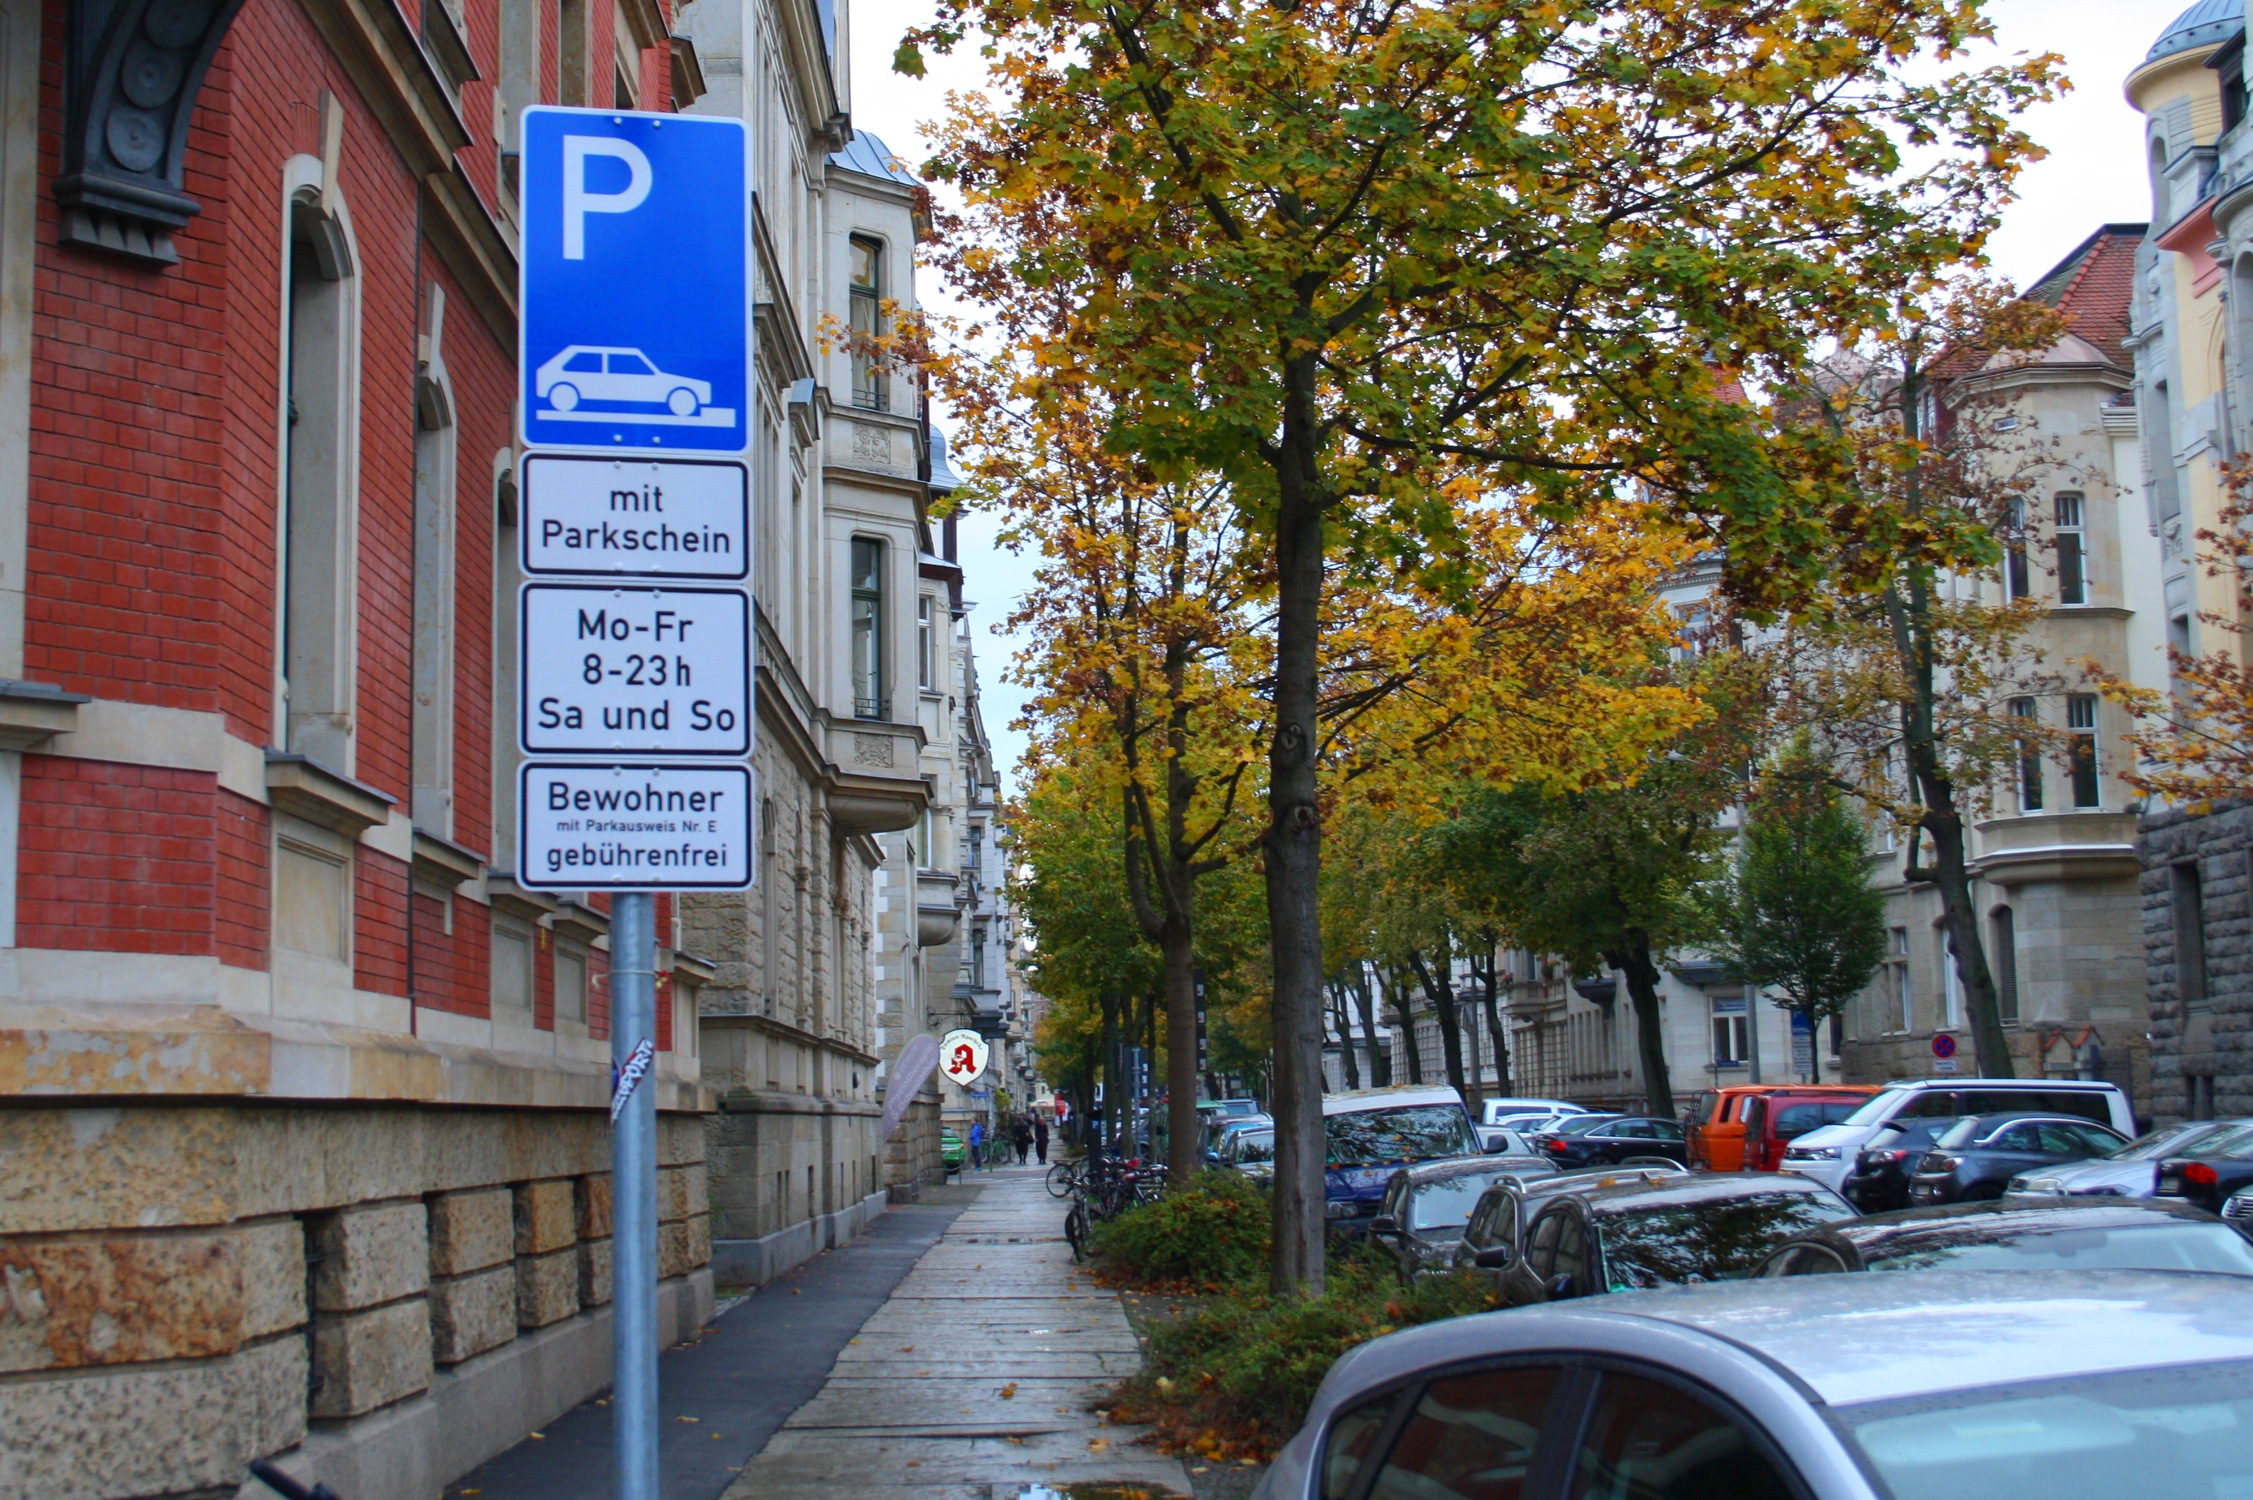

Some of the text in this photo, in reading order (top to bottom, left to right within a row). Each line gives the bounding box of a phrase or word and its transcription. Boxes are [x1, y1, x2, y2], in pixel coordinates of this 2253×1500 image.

[562, 134, 653, 261] P
[610, 483, 663, 513] mit
[542, 518, 730, 554] Parkschein
[578, 608, 694, 643] Mo-Fr
[538, 696, 735, 732] Sa und So
[548, 781, 724, 813] Bewohner
[556, 818, 717, 833] mit Parkausweis Nr. E
[547, 842, 727, 873] gebührenfrei
